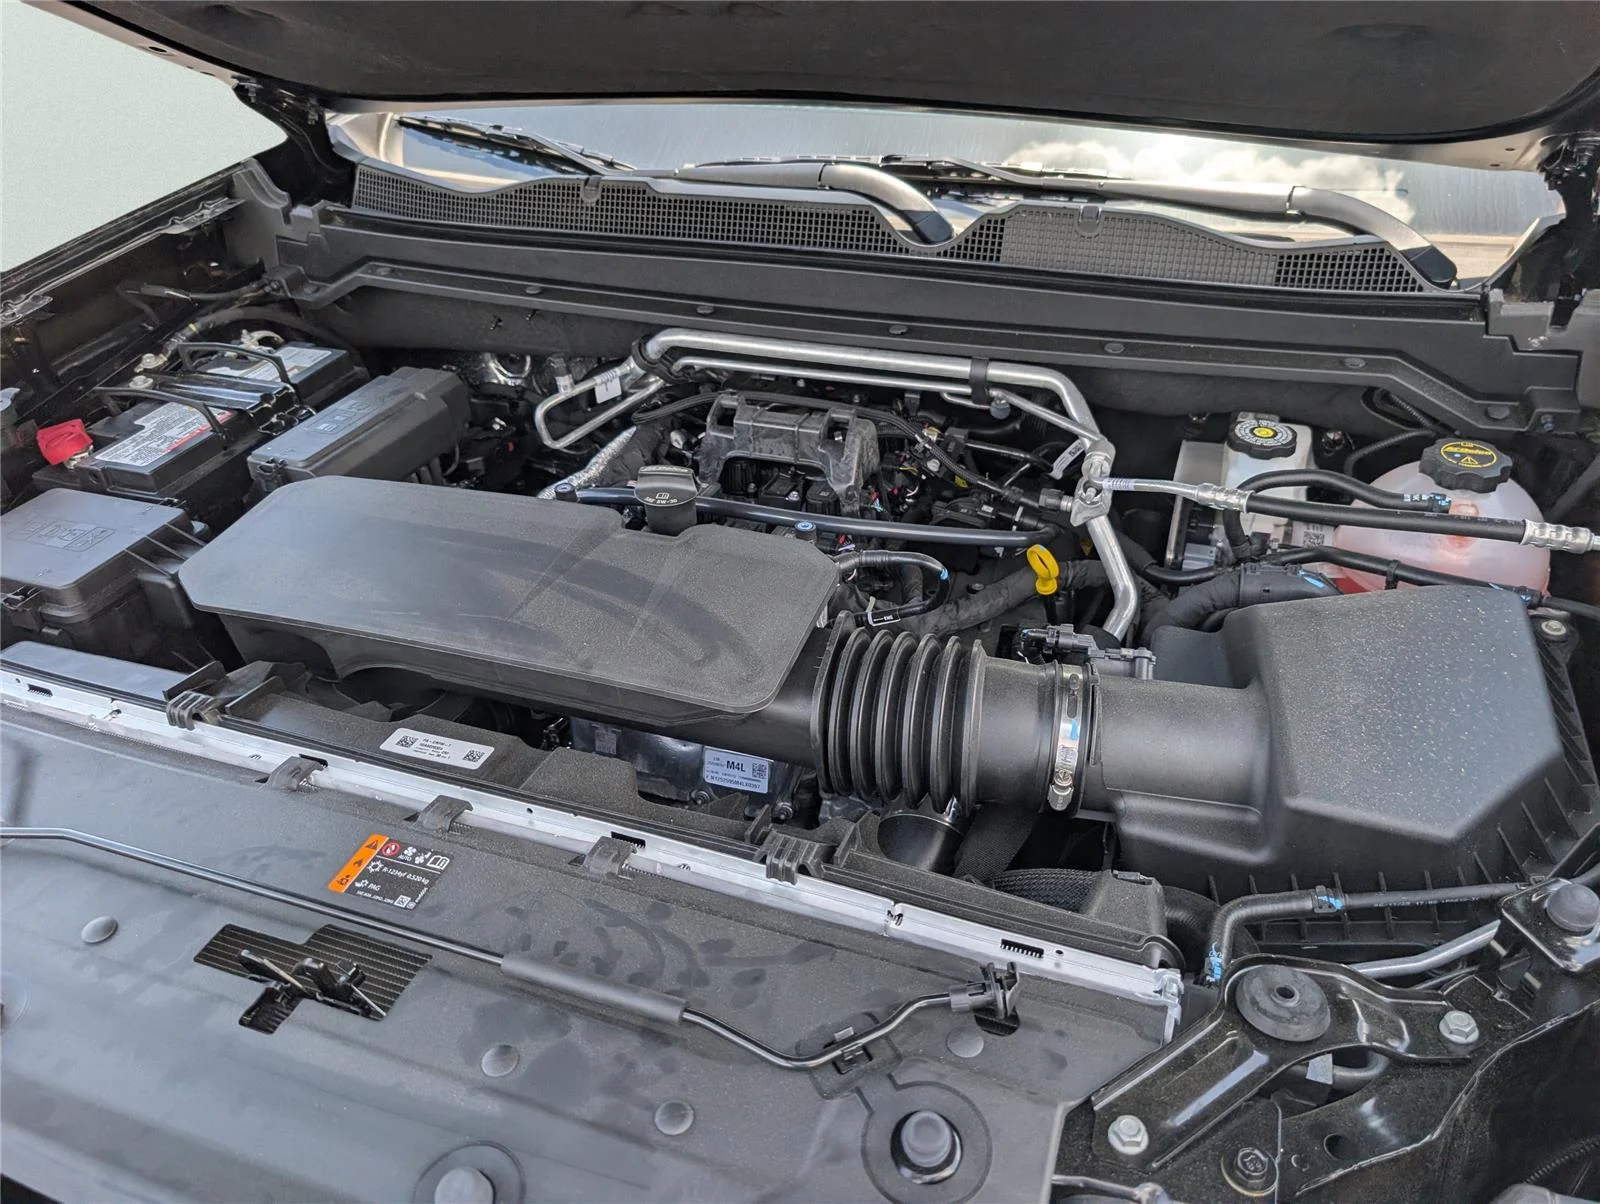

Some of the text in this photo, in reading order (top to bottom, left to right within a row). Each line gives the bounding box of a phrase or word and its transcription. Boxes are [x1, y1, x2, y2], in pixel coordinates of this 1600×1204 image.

[726, 760, 746, 772] M4L
[397, 854, 413, 862] AUTO
[381, 866, 407, 878] R-1234yf
[367, 883, 382, 892] PAG
